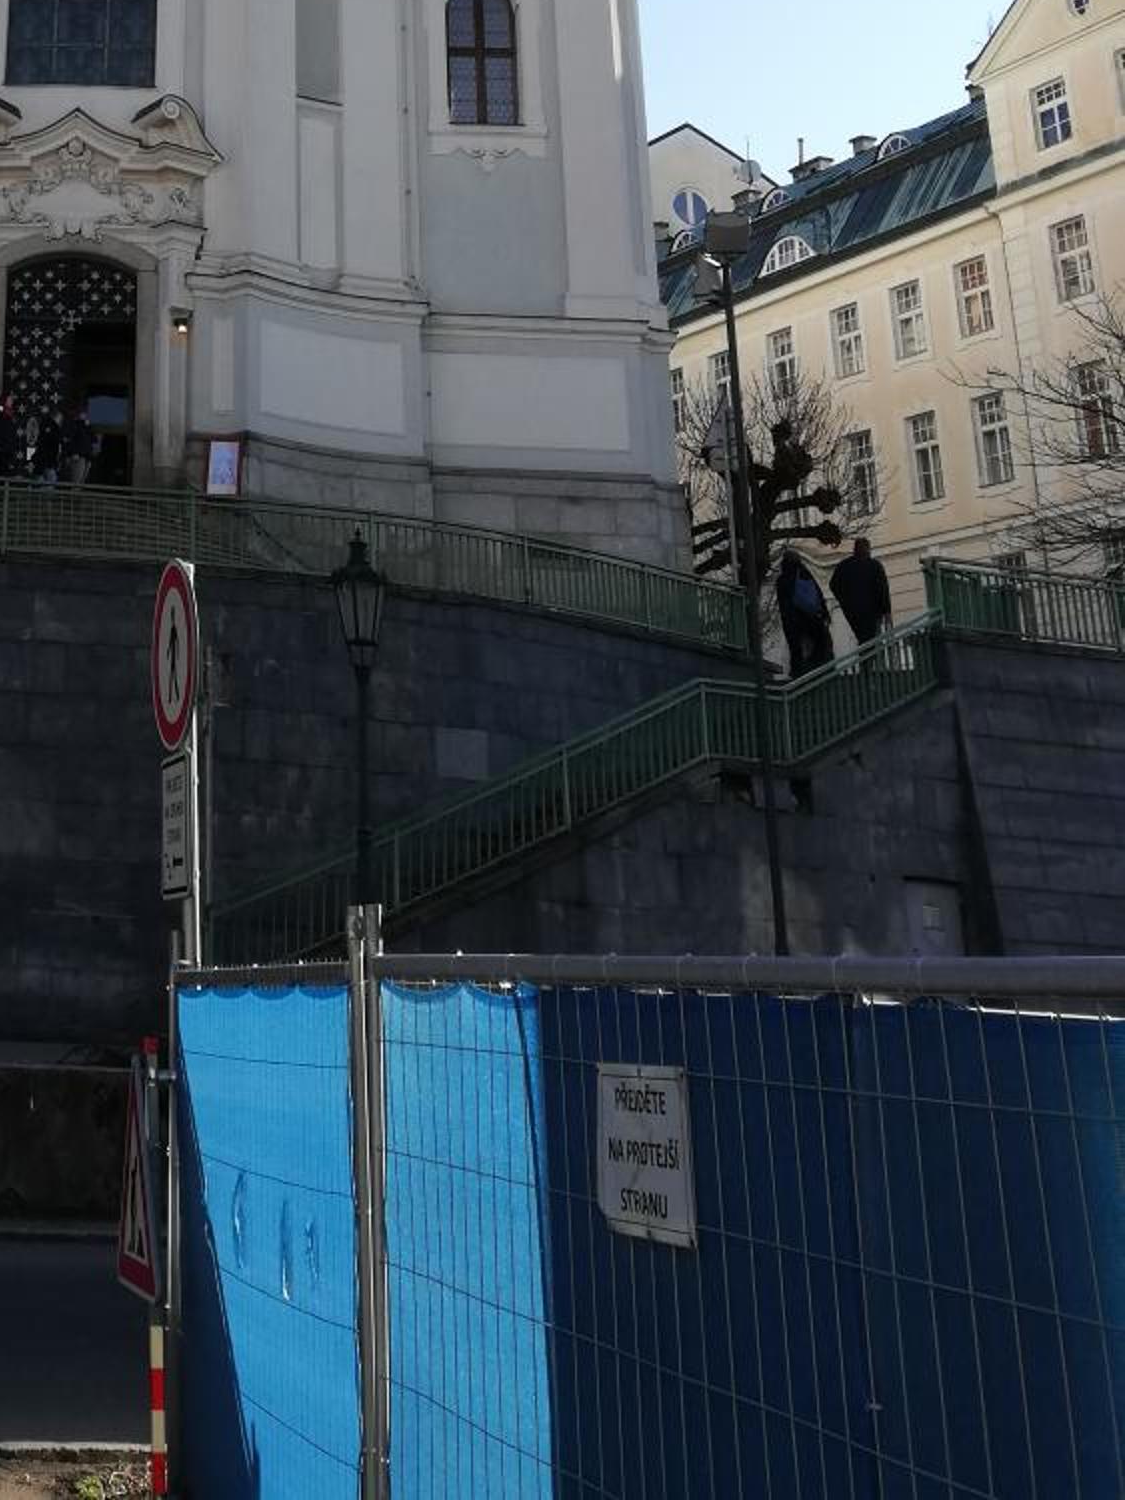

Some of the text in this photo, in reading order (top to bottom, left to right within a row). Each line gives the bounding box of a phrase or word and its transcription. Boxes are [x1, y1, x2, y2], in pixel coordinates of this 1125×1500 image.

[614, 1081, 667, 1116] PŘEJDĚTE
[607, 1136, 625, 1162] NA
[620, 1187, 668, 1220] STRANU
